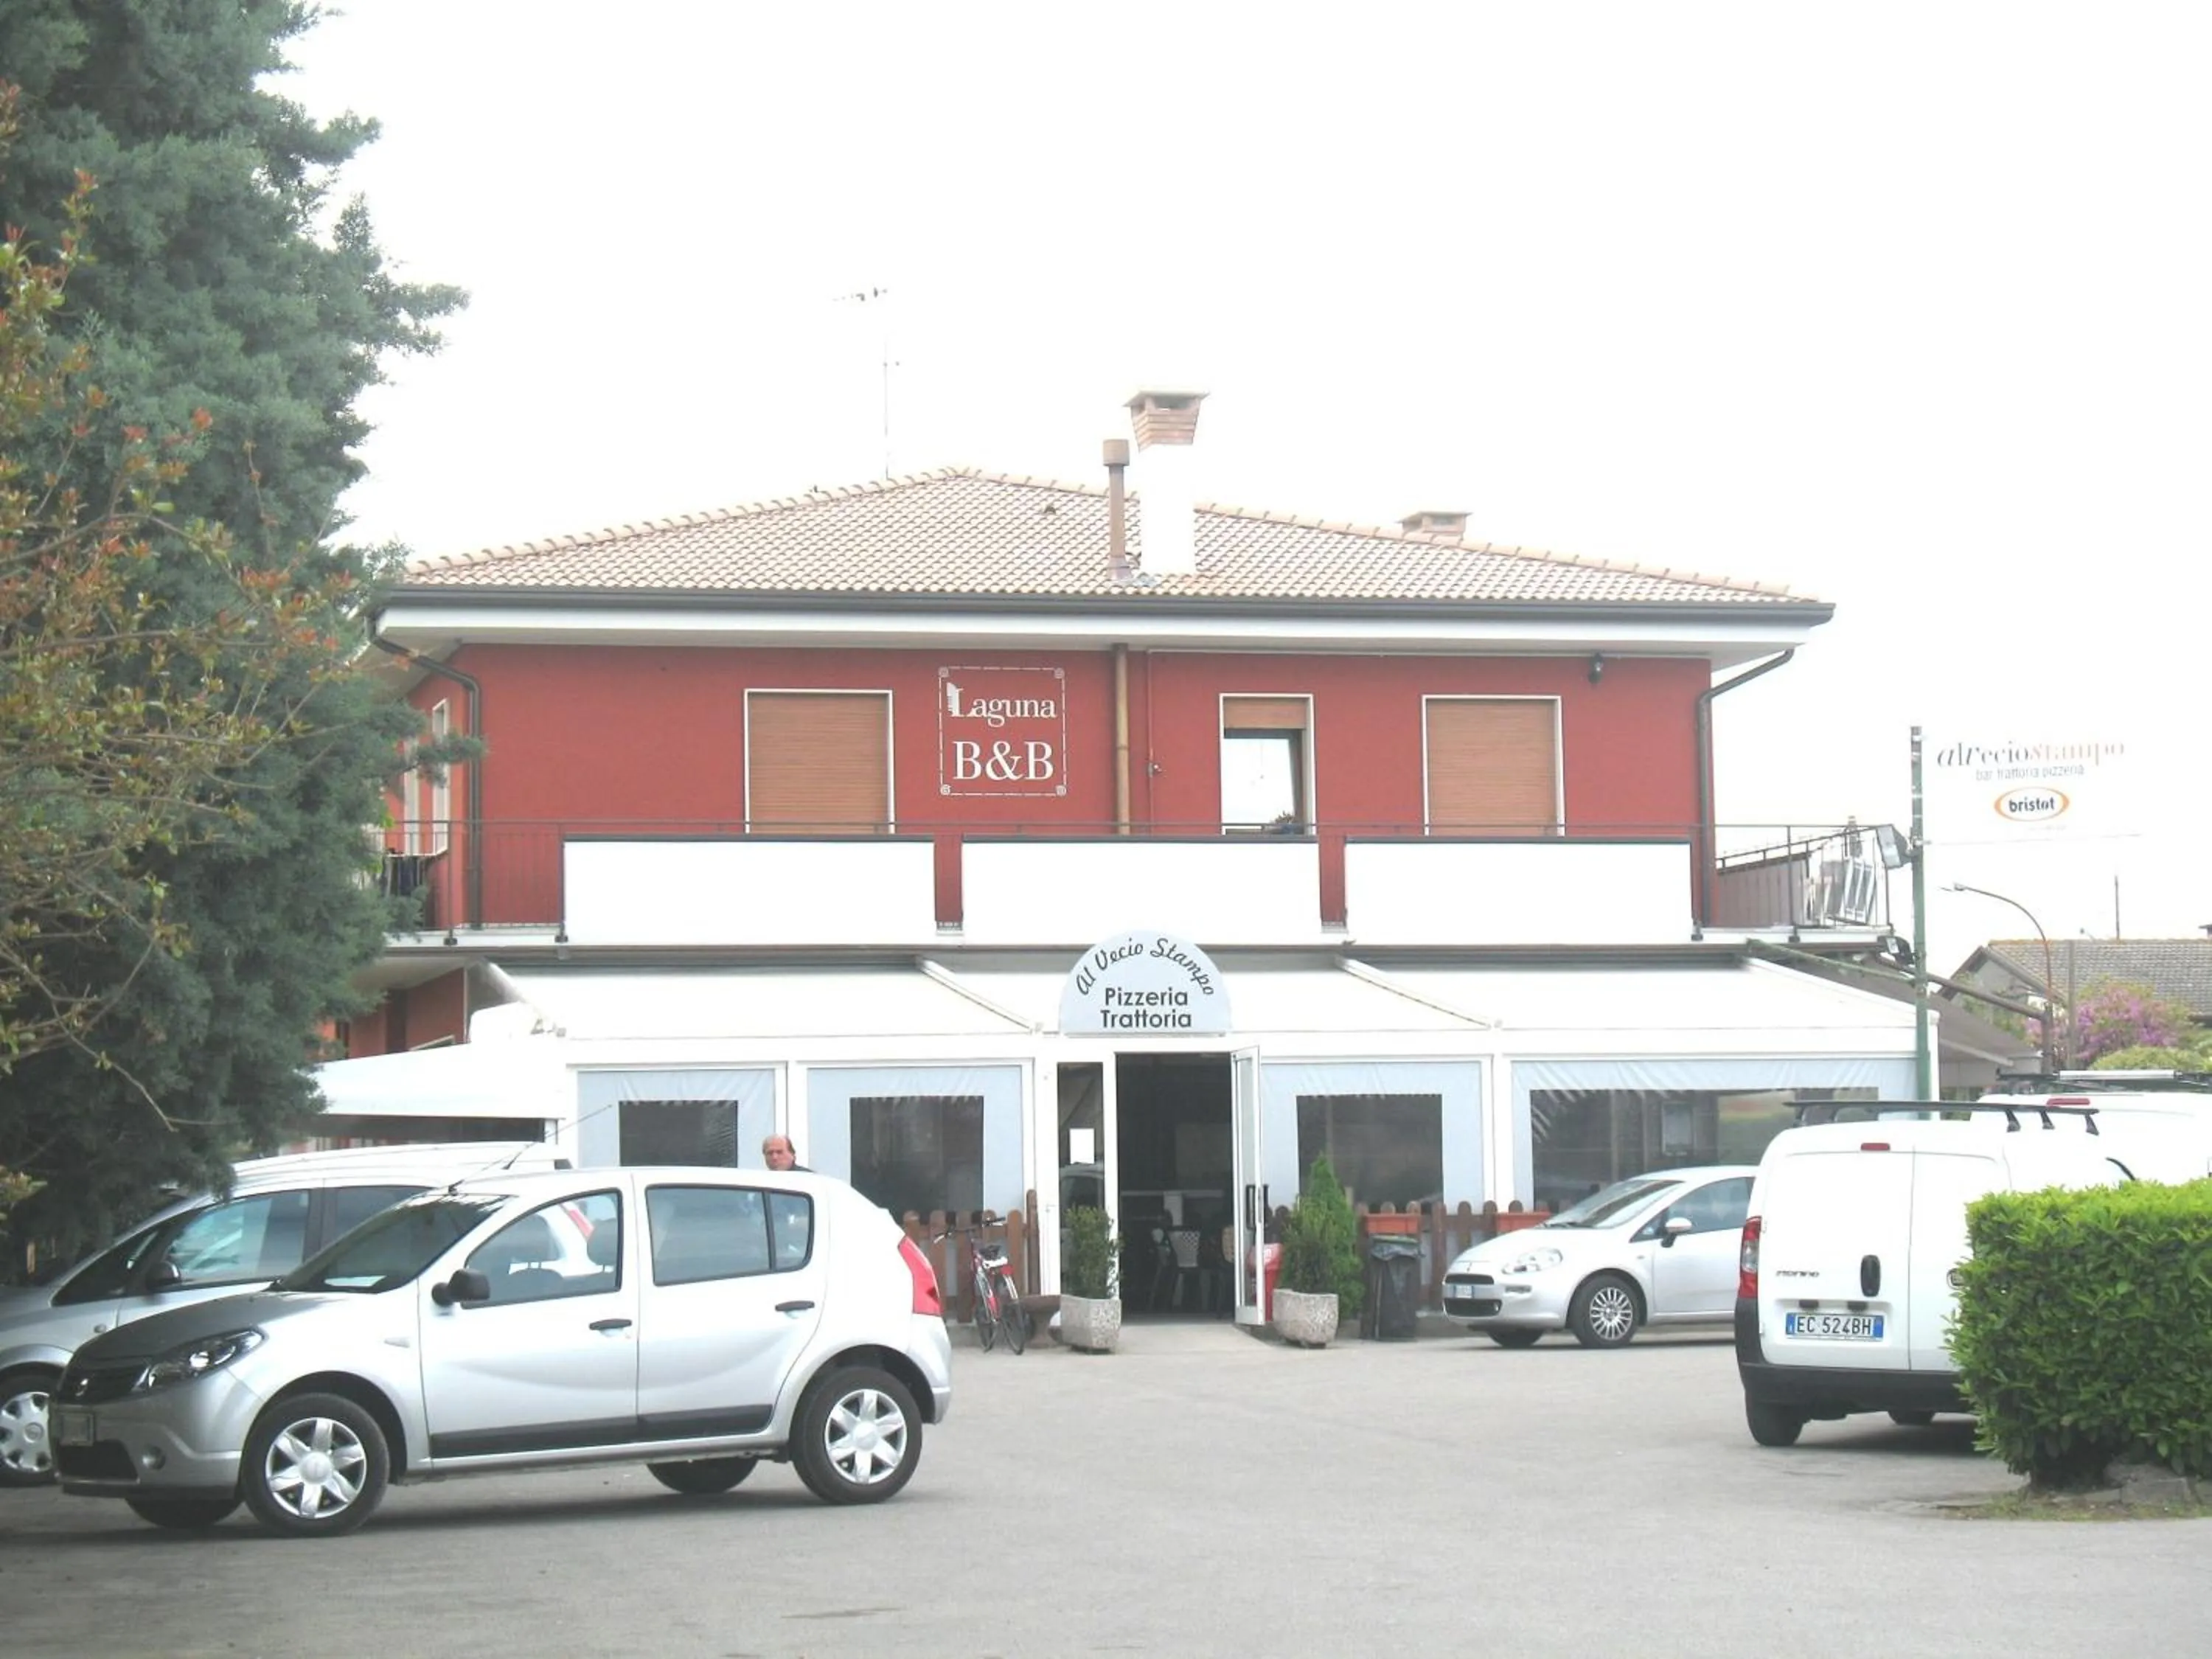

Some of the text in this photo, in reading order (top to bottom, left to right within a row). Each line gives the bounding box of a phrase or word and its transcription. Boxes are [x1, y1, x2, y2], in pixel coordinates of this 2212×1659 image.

[947, 686, 1057, 728] Laguna
[952, 740, 1054, 781] B&B
[2008, 796, 2055, 813] bristot
[1076, 937, 1214, 996] Al Vecio Stampo
[1105, 987, 1189, 1006] Pizzeria
[1099, 1009, 1192, 1029] Trattoria
[1797, 1316, 1816, 1333] EC
[1822, 1317, 1871, 1335] 524BH
